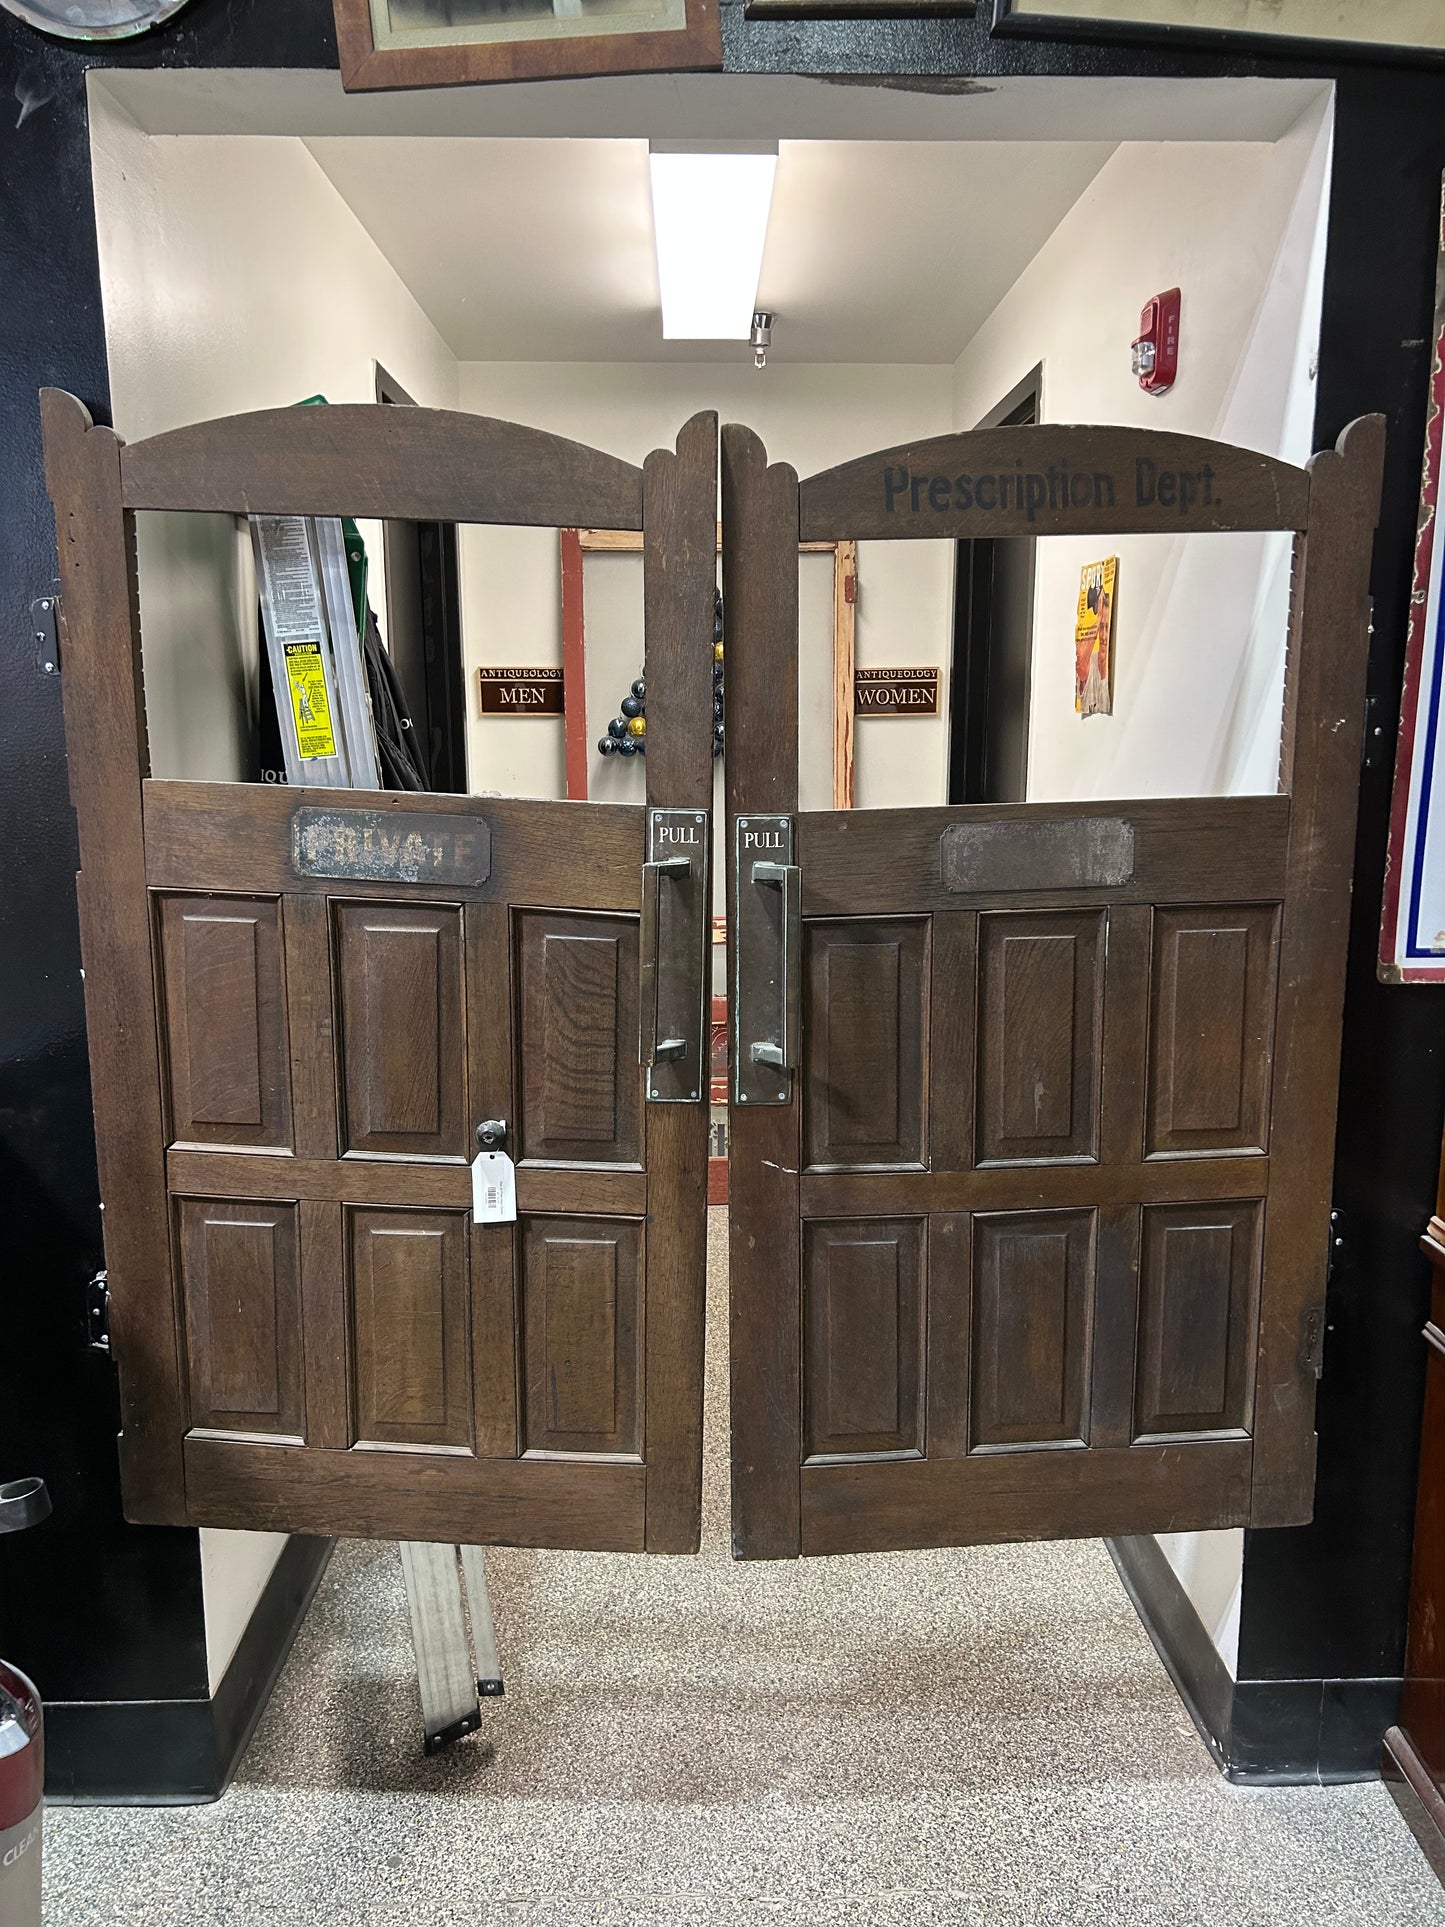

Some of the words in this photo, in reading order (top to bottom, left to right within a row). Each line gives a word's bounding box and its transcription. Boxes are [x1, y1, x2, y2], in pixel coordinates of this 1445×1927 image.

[1166, 314, 1175, 355] FIRE
[884, 458, 1115, 520] Prescription
[1135, 457, 1222, 514] Dept.
[287, 643, 317, 654] CAUTION
[480, 669, 563, 678] ANTIQUEOLOGY
[856, 670, 937, 680] ANTIQUEOLOGY
[499, 687, 547, 704] MEN
[856, 687, 936, 705] WOMEN
[658, 826, 699, 844] PULL
[744, 832, 785, 849] PULL
